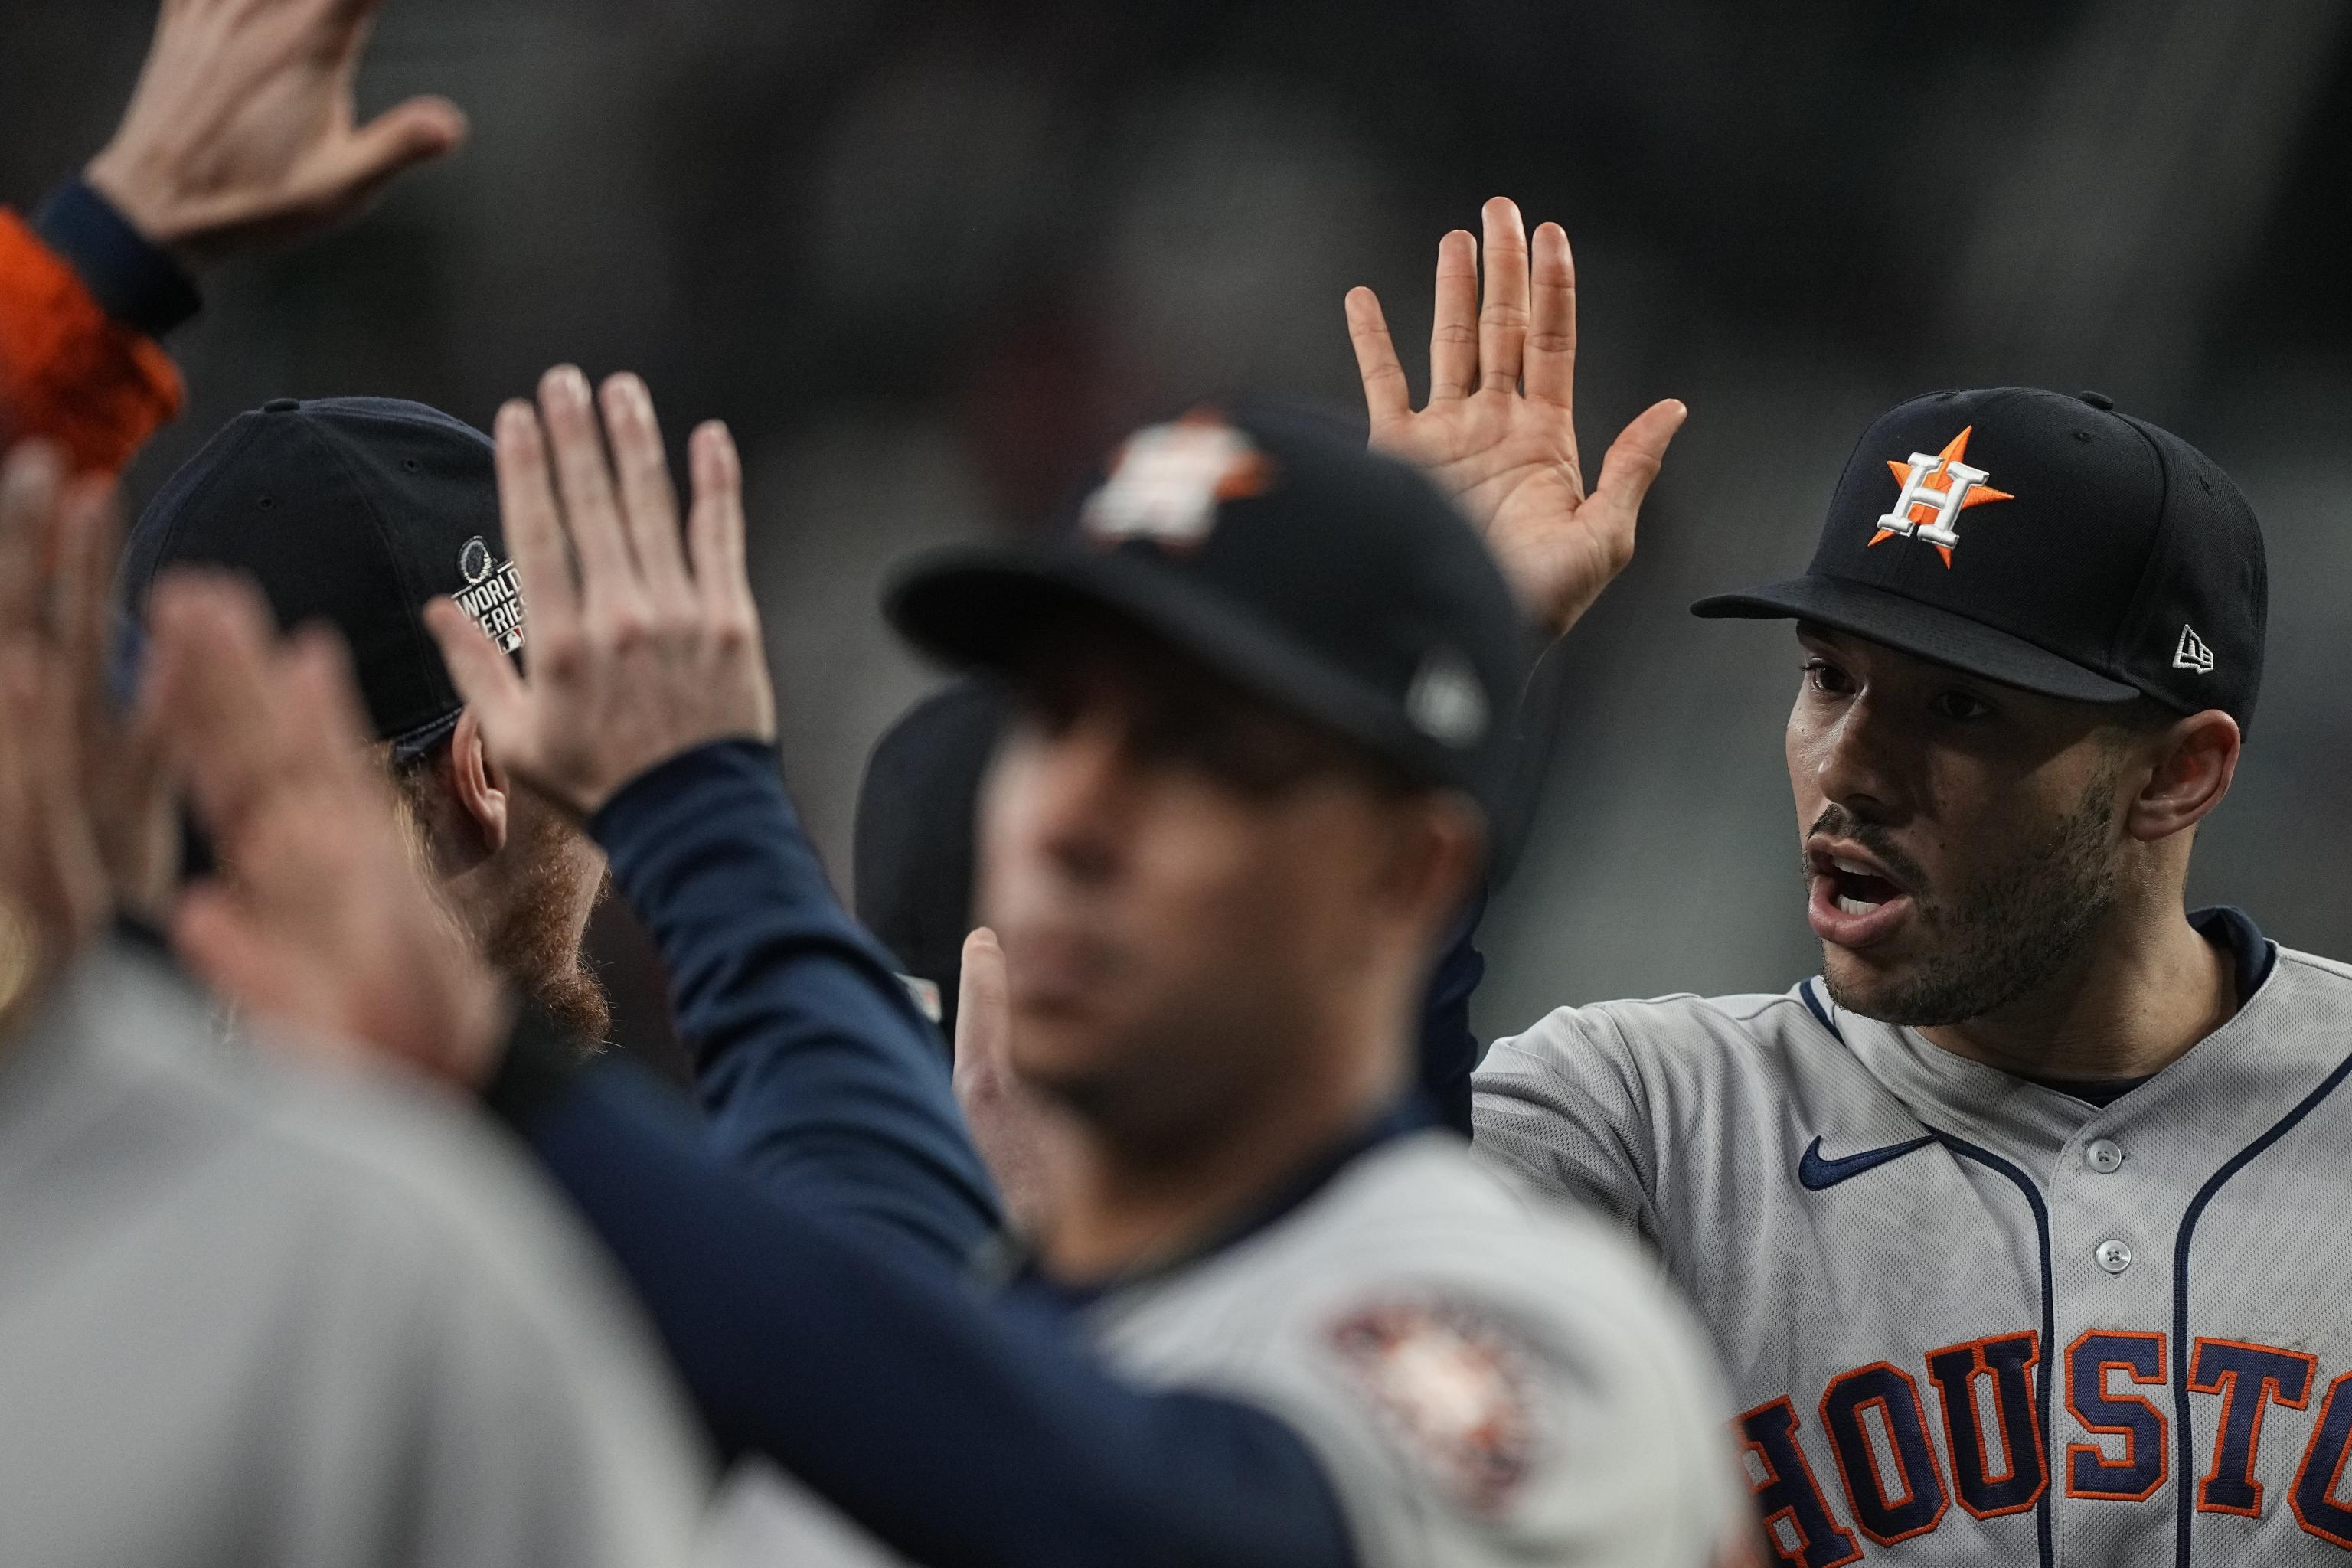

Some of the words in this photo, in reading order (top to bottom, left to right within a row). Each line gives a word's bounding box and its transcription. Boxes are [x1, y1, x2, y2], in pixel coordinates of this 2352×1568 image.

[1877, 452, 1990, 549] H
[454, 568, 524, 622] WORLD
[472, 594, 528, 639] ERIE
